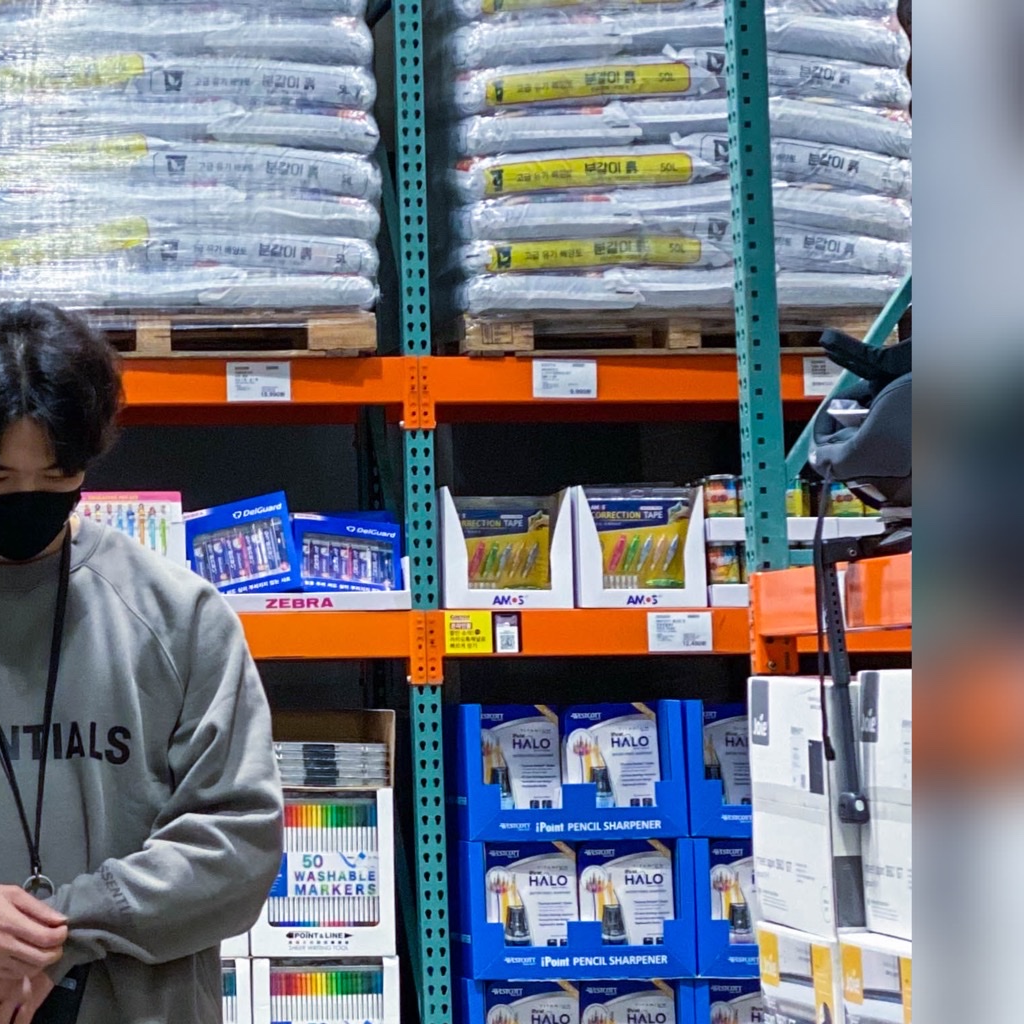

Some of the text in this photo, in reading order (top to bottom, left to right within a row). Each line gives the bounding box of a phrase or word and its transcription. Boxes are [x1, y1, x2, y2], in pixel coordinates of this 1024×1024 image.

[262, 74, 300, 88] 분갈이
[584, 70, 620, 85] 분갈이
[266, 160, 303, 176] 분갈이
[259, 243, 296, 258] 분갈이
[243, 503, 282, 517] DelGuard
[504, 520, 524, 528] TAPE
[356, 526, 396, 538] DelGuard
[266, 597, 334, 609] ZEBRA
[512, 738, 550, 749] HALO
[611, 736, 649, 748] HALO
[536, 822, 564, 833] iPoint
[568, 821, 602, 832] PENCIL
[604, 820, 662, 831] SHARPENER
[302, 854, 324, 869] 50
[294, 870, 376, 882] WASHABLE
[529, 875, 568, 886] HALO
[625, 874, 664, 884] HALO
[294, 884, 376, 896] MARKERS
[541, 956, 570, 967] iPoint
[573, 956, 607, 966] PENCIL
[609, 955, 668, 966] SHARPENER
[531, 1014, 570, 1024] HALO
[627, 1013, 666, 1024] HALO
